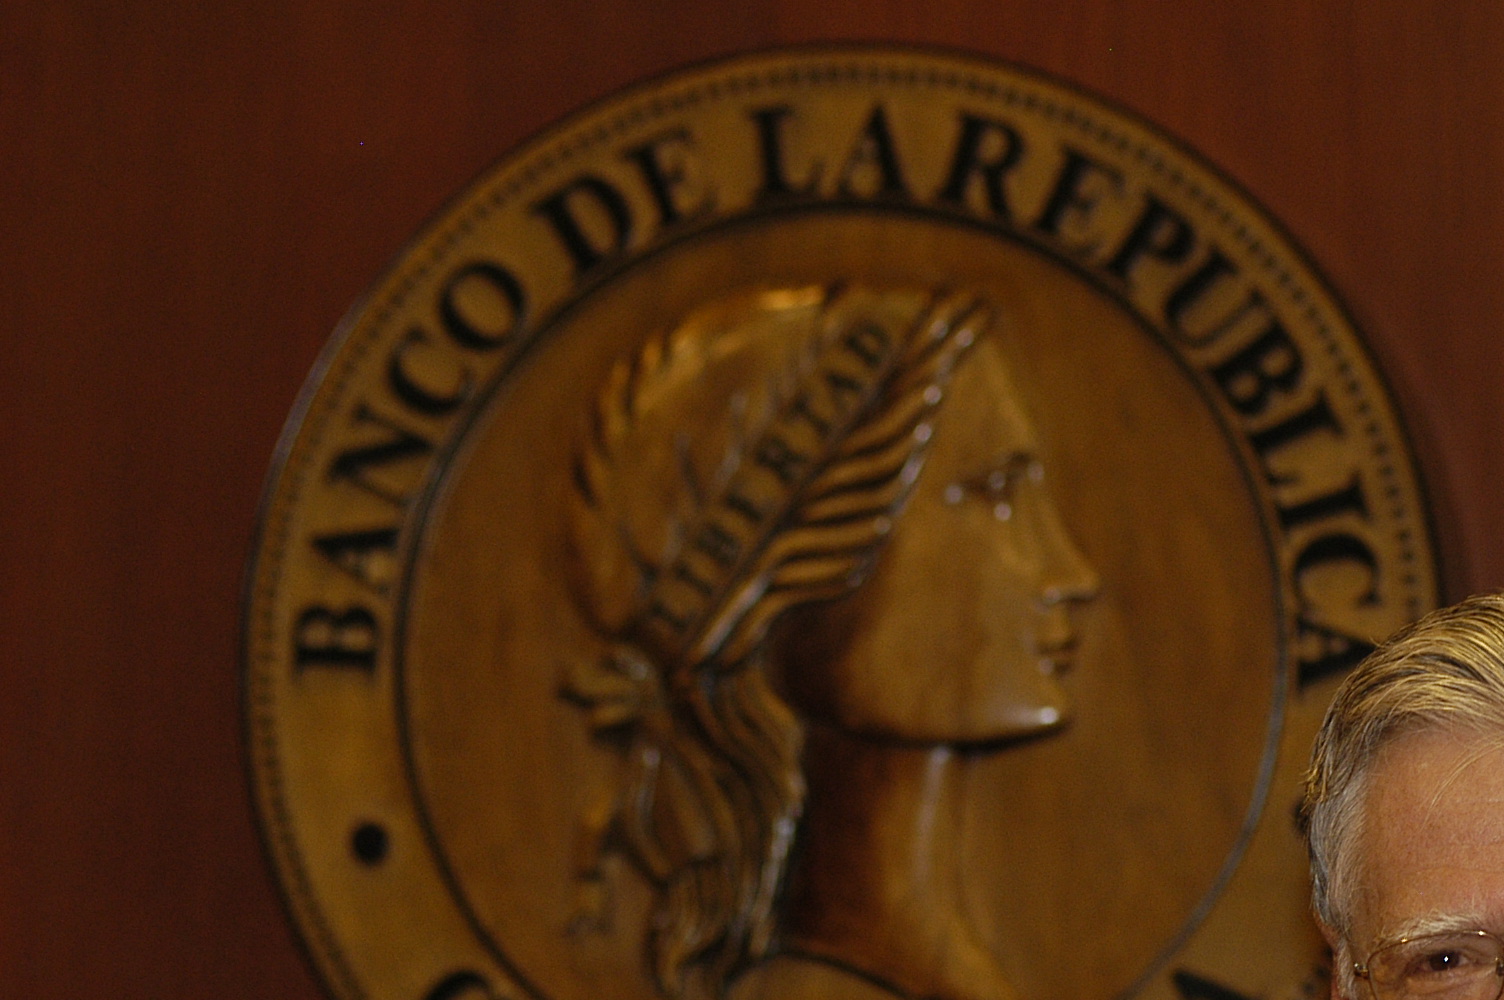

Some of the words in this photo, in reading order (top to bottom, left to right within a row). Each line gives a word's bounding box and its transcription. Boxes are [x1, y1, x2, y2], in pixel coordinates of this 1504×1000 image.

[293, 260, 526, 682] BANCO
[529, 124, 721, 275] DE
[746, 103, 918, 200] LA
[931, 108, 1382, 692] REPUBLICA
[645, 319, 892, 637] LIBERTAD
